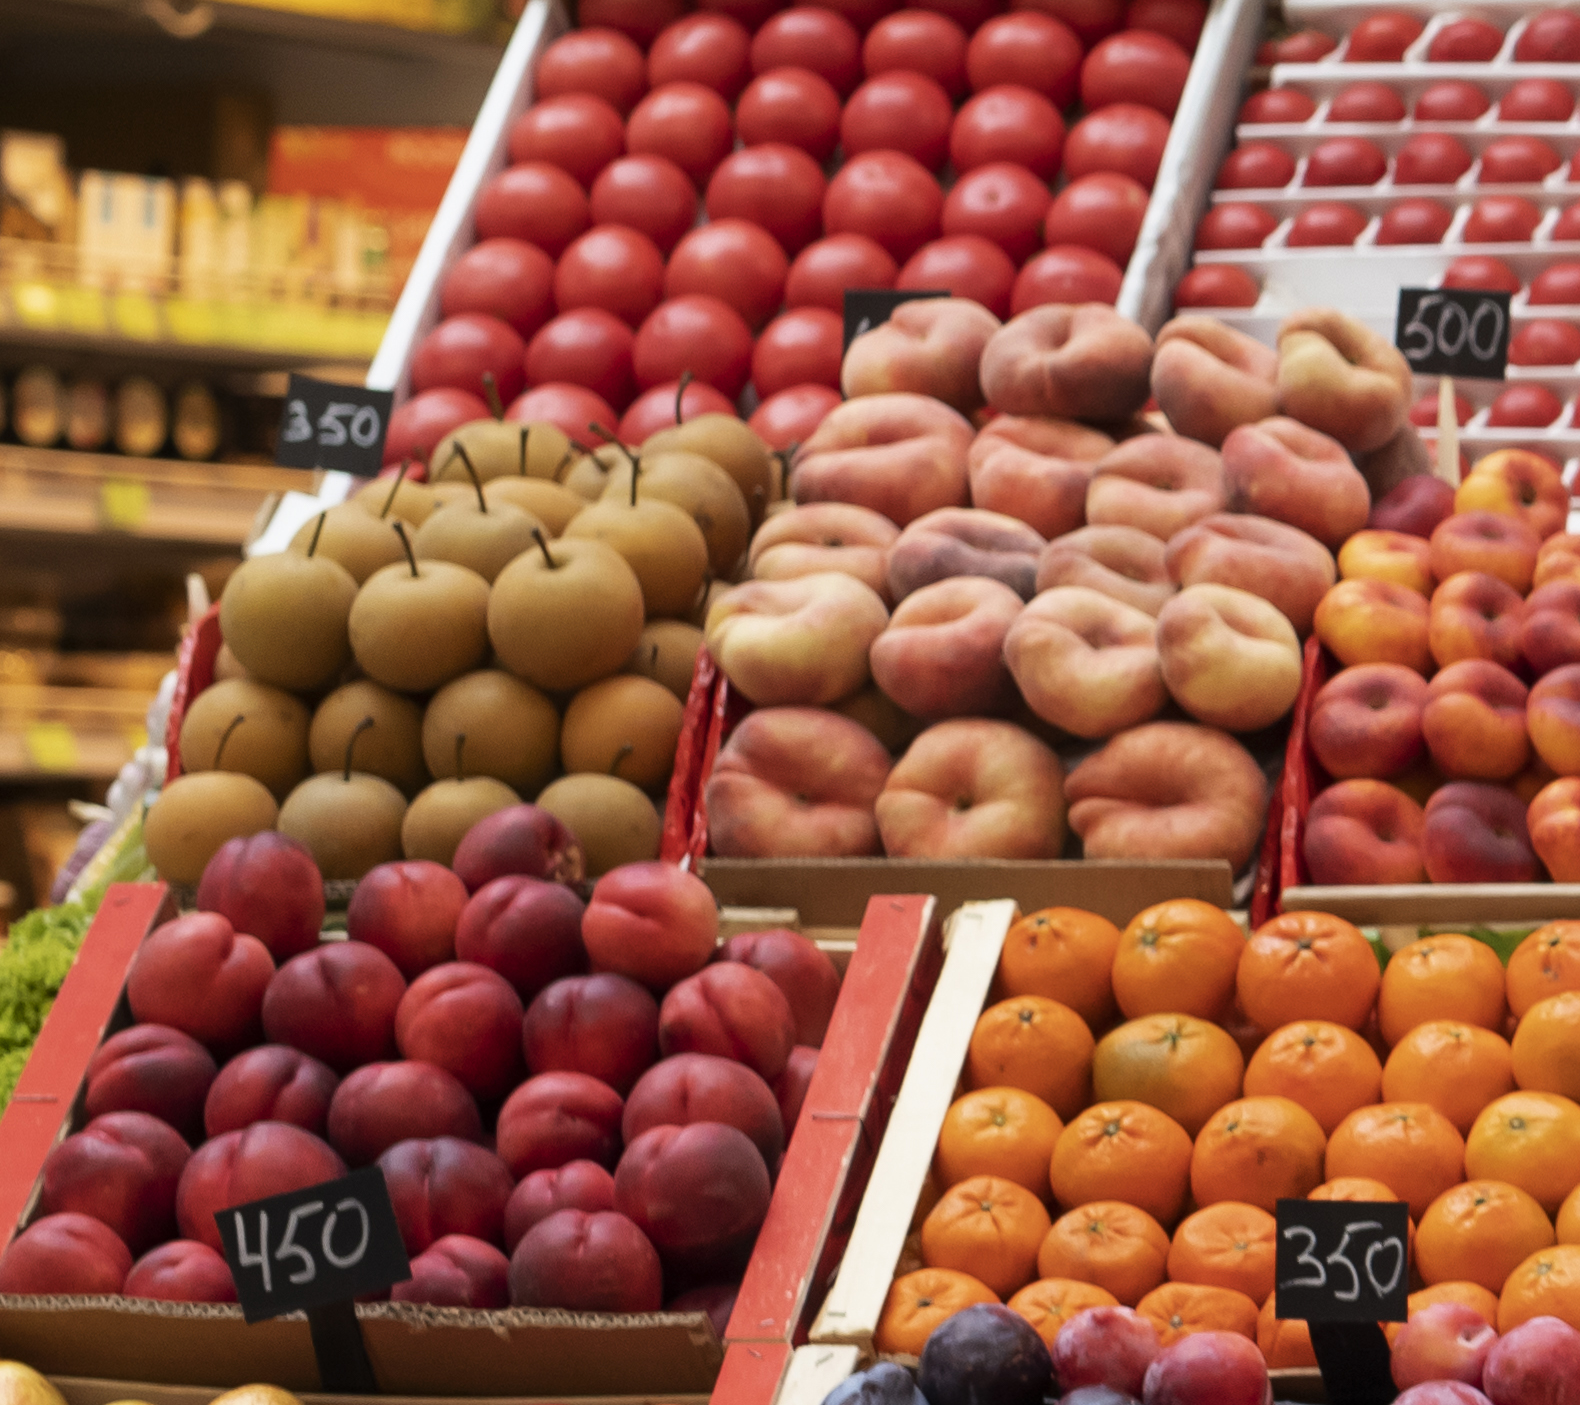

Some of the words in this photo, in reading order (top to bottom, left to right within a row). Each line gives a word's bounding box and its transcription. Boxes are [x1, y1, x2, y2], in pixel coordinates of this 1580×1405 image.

[1403, 295, 1504, 361] 500
[283, 399, 380, 448] 350
[234, 1197, 370, 1292] 450
[1279, 1220, 1404, 1301] 350
